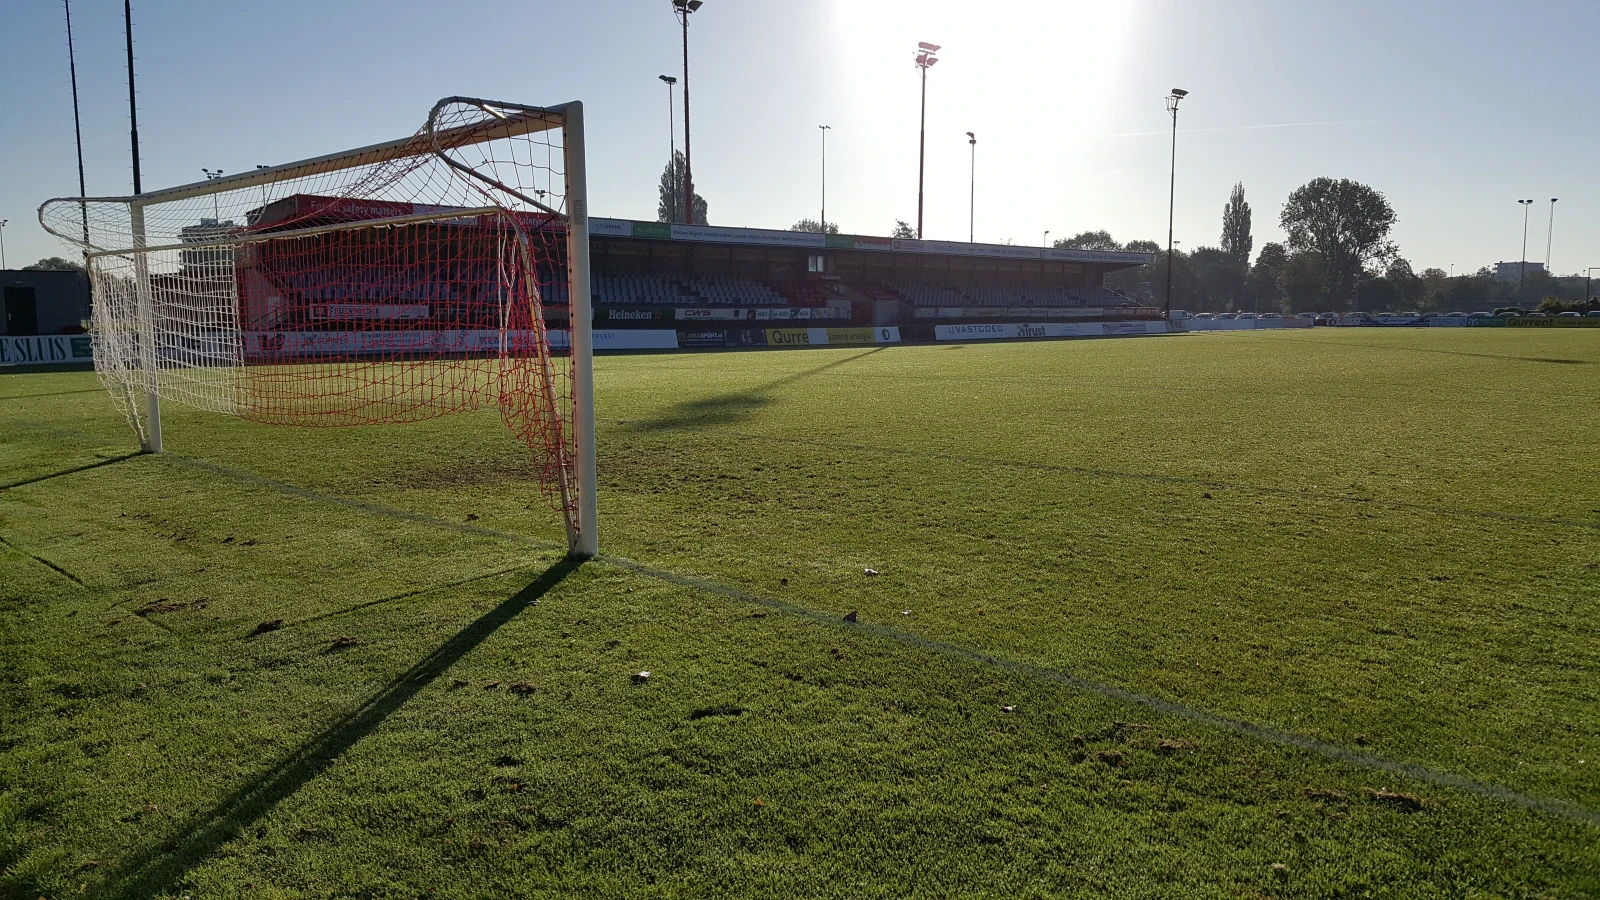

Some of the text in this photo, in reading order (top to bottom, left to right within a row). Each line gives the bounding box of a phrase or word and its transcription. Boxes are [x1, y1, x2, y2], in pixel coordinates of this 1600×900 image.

[342, 204, 369, 216] safety
[370, 207, 403, 216] matters
[608, 310, 652, 320] Heineken
[1508, 318, 1553, 326] Qurrent
[850, 332, 872, 342] energie
[14, 336, 67, 361] SLUIS
